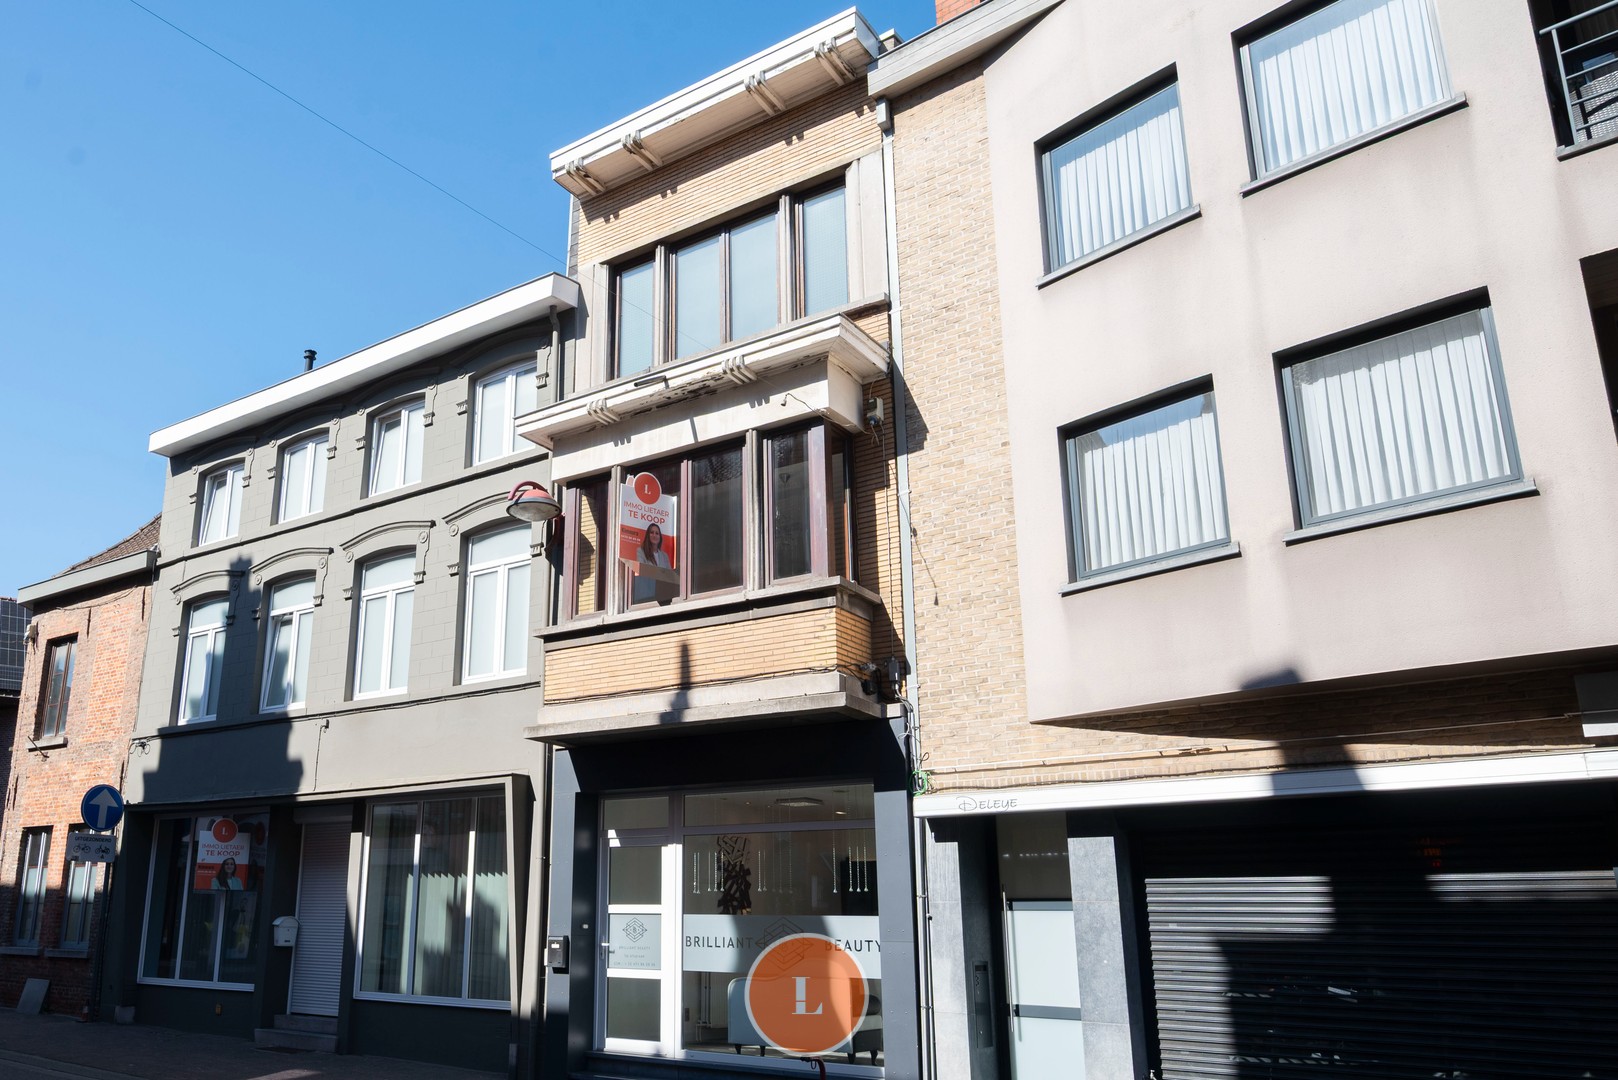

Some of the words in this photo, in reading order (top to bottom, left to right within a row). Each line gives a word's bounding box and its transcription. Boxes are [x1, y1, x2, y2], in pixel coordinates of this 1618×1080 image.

[644, 484, 652, 495] L
[623, 500, 643, 511] IMMO
[643, 506, 670, 518] LIETAER
[628, 510, 639, 519] TE
[640, 513, 666, 525] KOOP
[685, 935, 753, 949] BRILLIANT
[825, 939, 881, 952] BEAUTY
